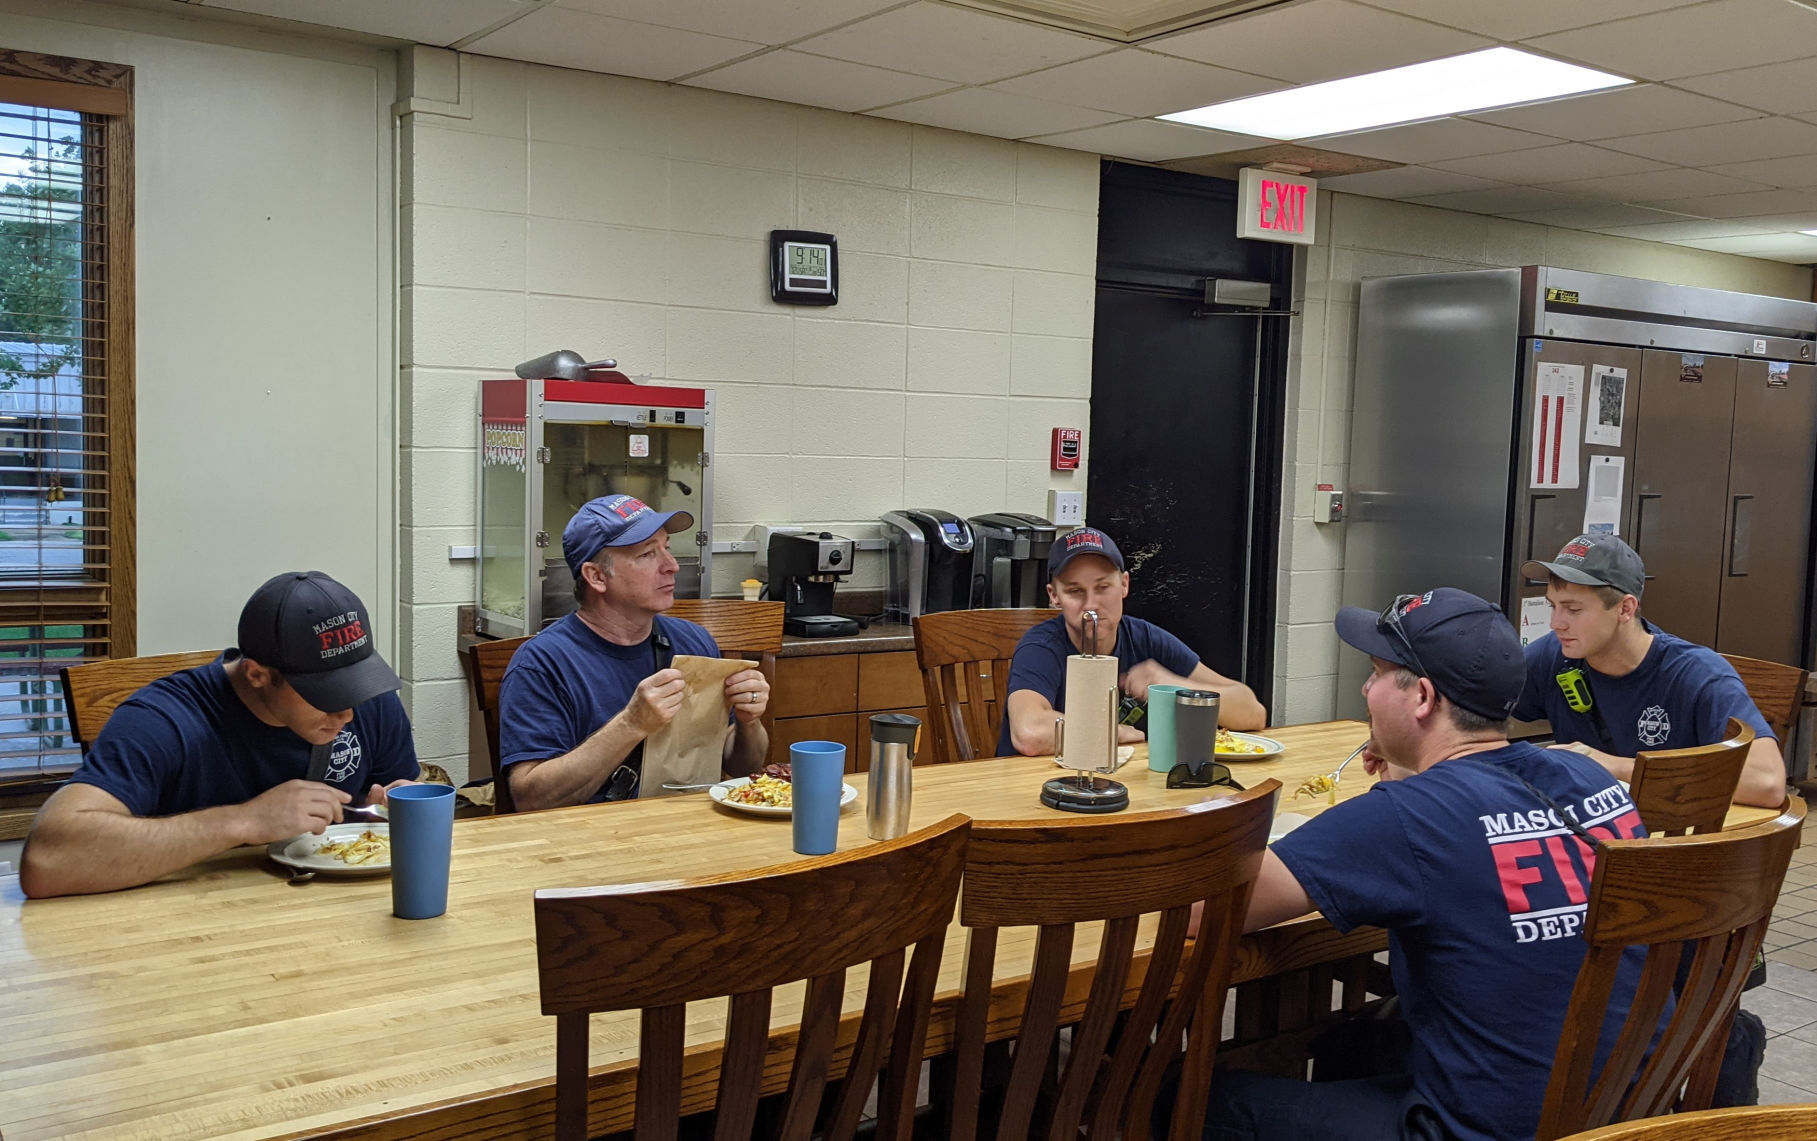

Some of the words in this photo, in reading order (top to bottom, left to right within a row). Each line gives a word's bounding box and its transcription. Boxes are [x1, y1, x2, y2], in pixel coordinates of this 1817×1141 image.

[1260, 180, 1308, 233] EXIT
[486, 430, 525, 449] POPCORN
[1061, 430, 1080, 440] FIRE
[1065, 529, 1086, 540] MASON
[1087, 529, 1102, 537] CITY
[1066, 534, 1103, 547] FIRE
[312, 614, 346, 635] MASON
[346, 611, 359, 622] CITY
[320, 620, 367, 650] FIRE
[320, 634, 369, 659] DEPARTMENT
[352, 746, 361, 757] D
[1583, 784, 1629, 817] CITY
